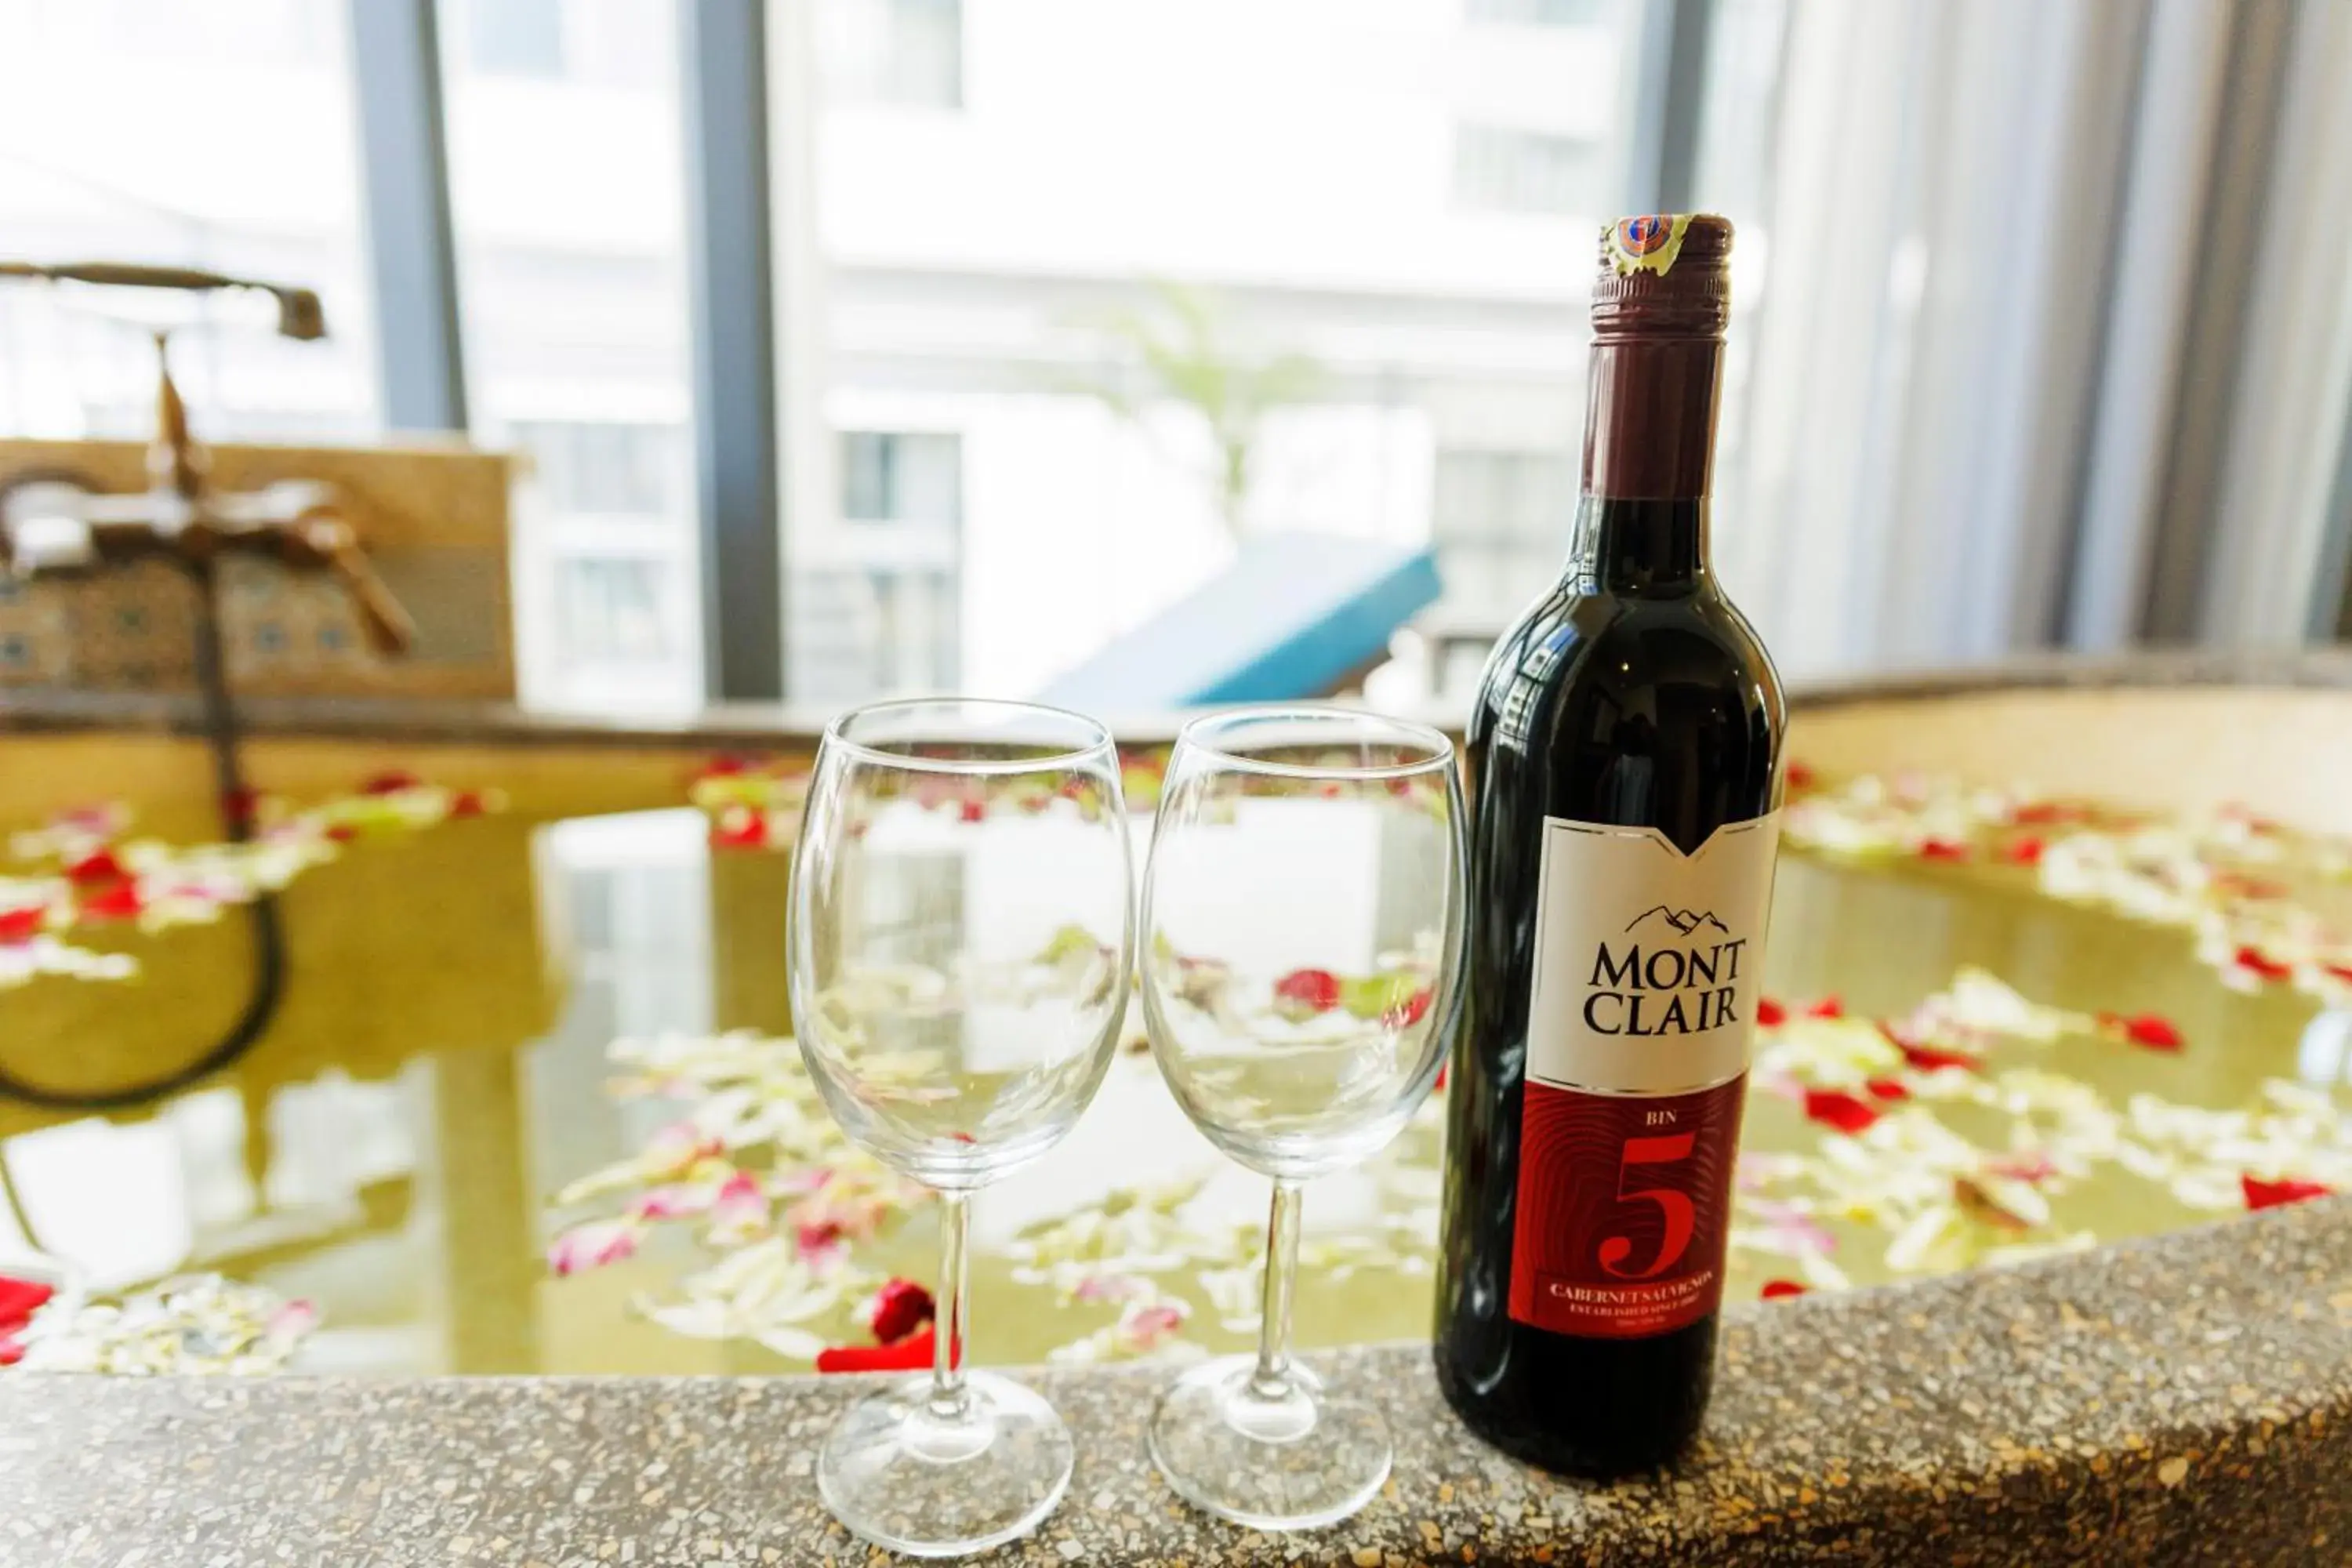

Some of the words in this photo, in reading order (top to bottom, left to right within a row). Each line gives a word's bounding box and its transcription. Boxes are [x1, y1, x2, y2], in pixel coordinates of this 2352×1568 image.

[1587, 938, 1747, 991] MONT
[1583, 986, 1739, 1036] CLAIR
[1646, 1109, 1677, 1126] BIN
[1599, 1131, 1697, 1279] 5
[1549, 1283, 1640, 1304] CABERNET
[1570, 1303, 1650, 1317] ESTABLISHED
